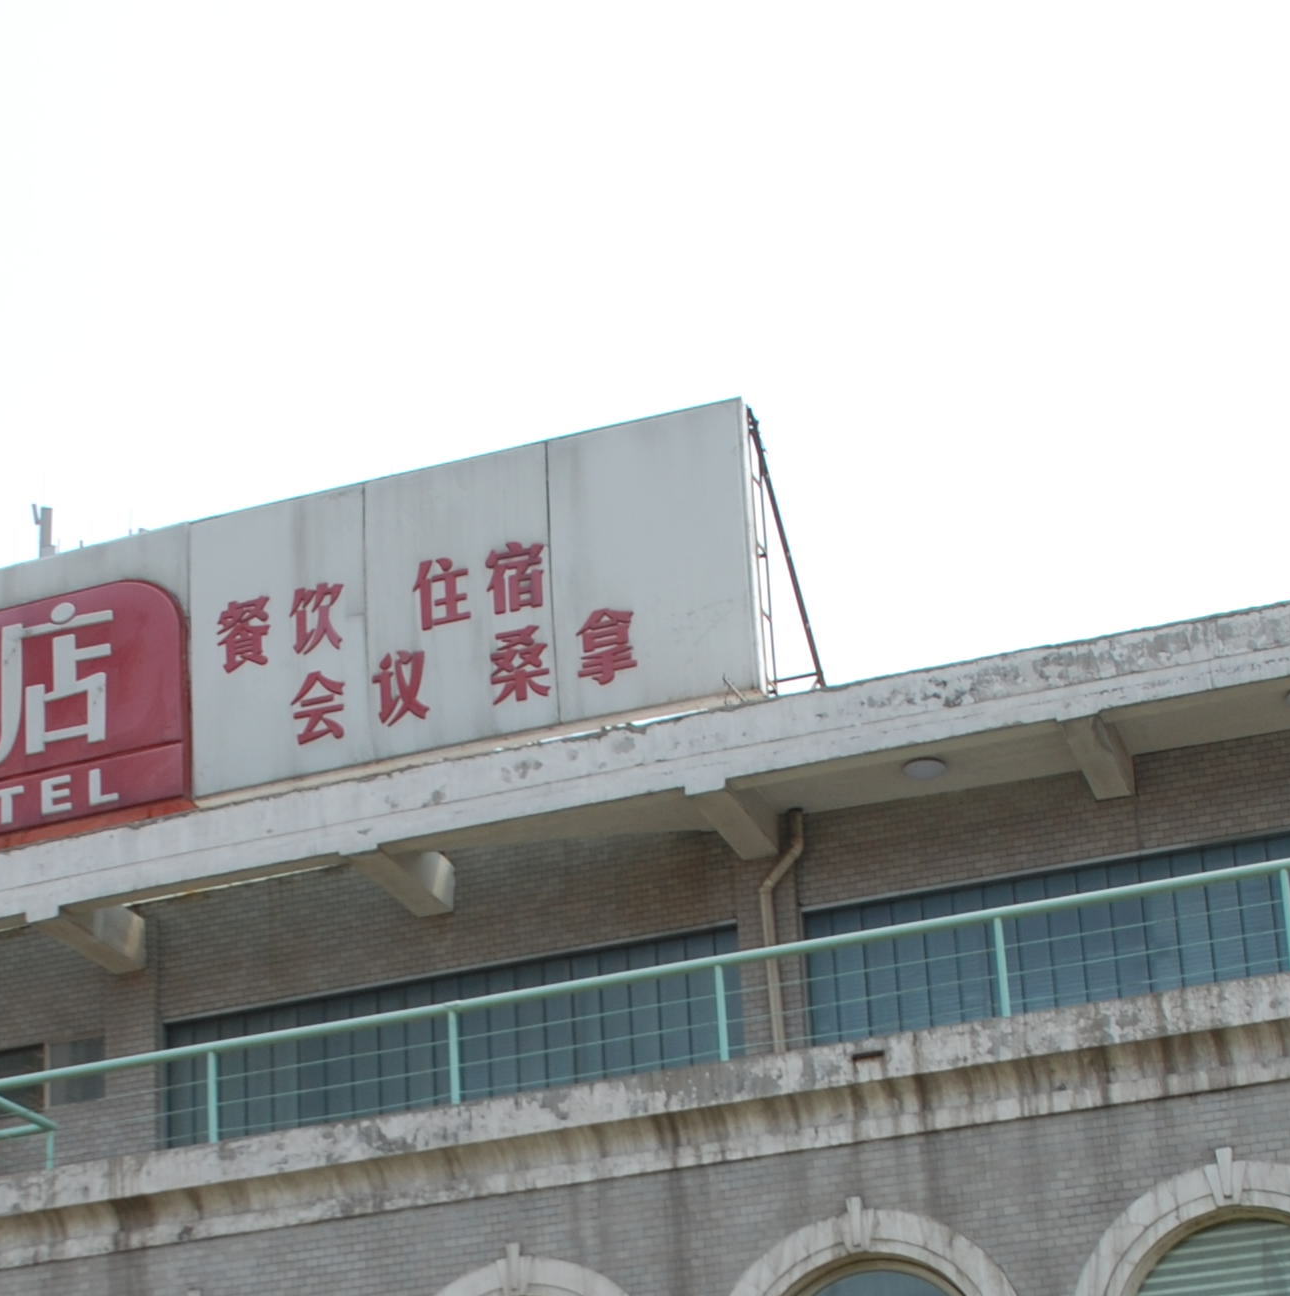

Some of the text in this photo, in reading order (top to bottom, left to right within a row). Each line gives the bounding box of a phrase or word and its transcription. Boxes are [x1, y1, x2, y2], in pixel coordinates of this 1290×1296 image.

[216, 541, 546, 675] 餐饮 住宿
[290, 607, 639, 746] 会议 桑拿
